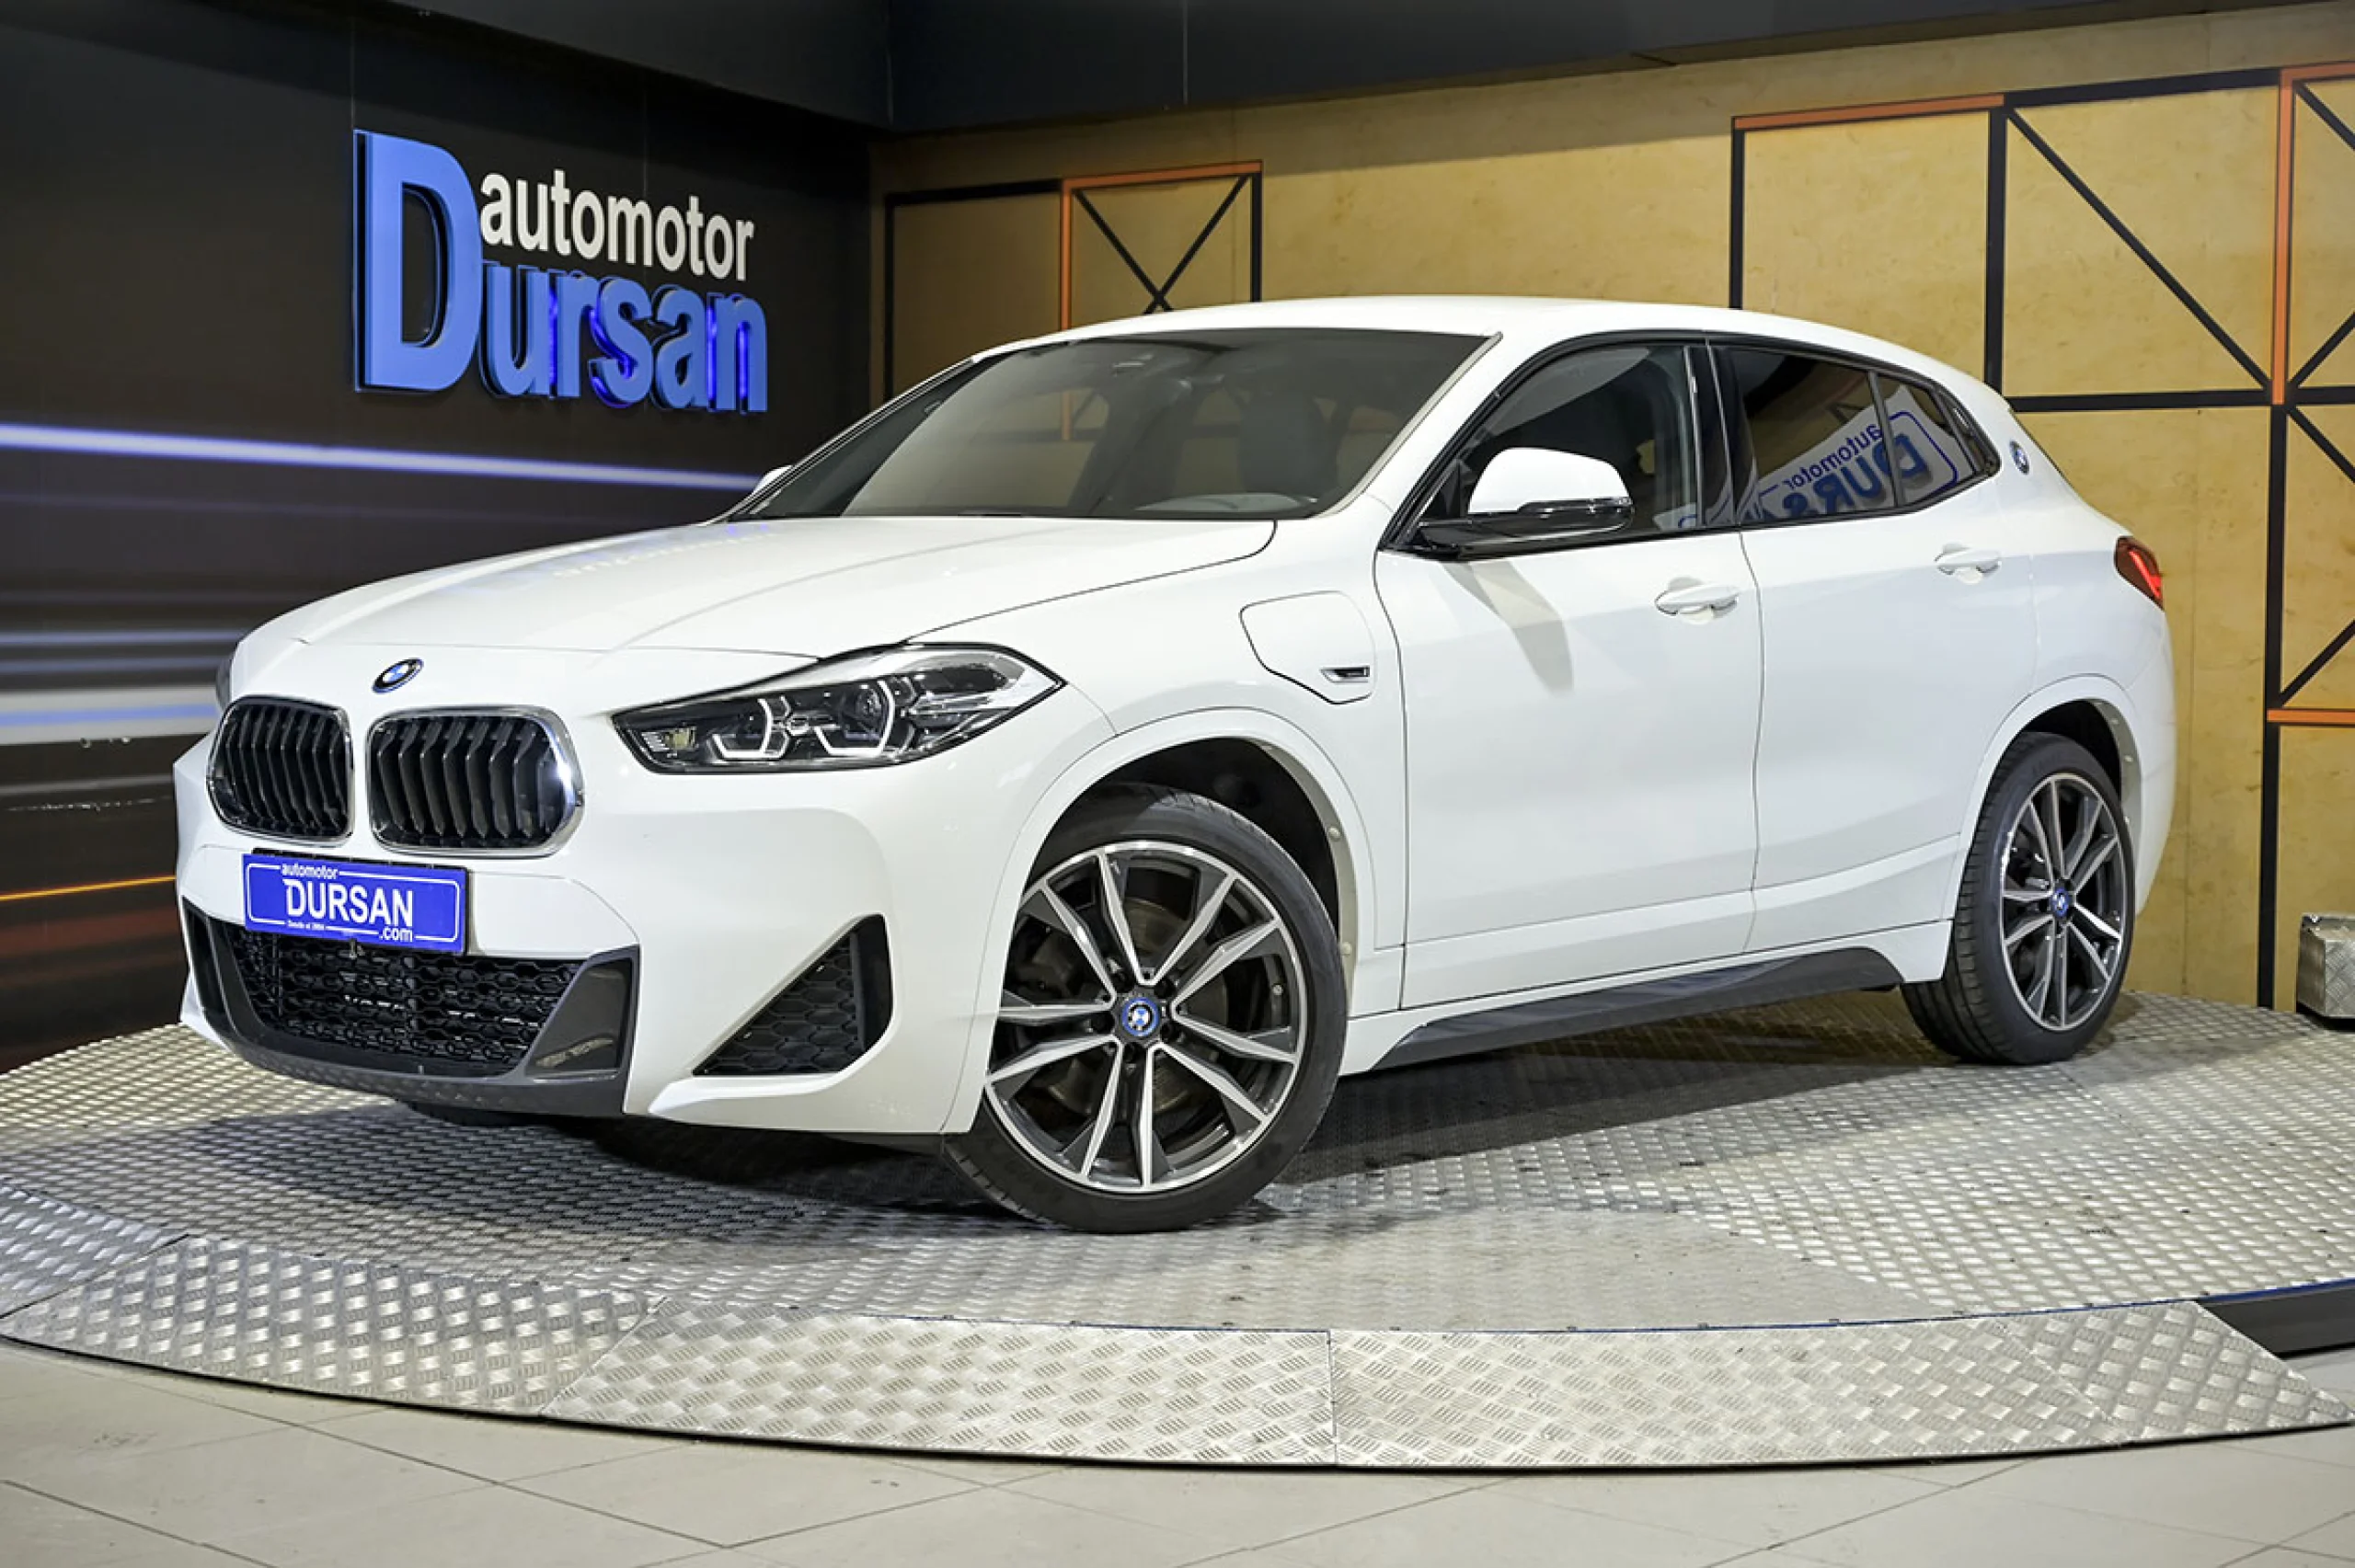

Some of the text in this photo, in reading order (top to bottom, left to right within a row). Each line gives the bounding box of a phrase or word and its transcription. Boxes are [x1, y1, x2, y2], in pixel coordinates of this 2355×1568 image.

[479, 169, 754, 280] automotor
[353, 129, 768, 415] Dursan
[281, 863, 338, 879] automotor
[282, 879, 413, 927] DURSAN
[379, 926, 413, 943] .com
